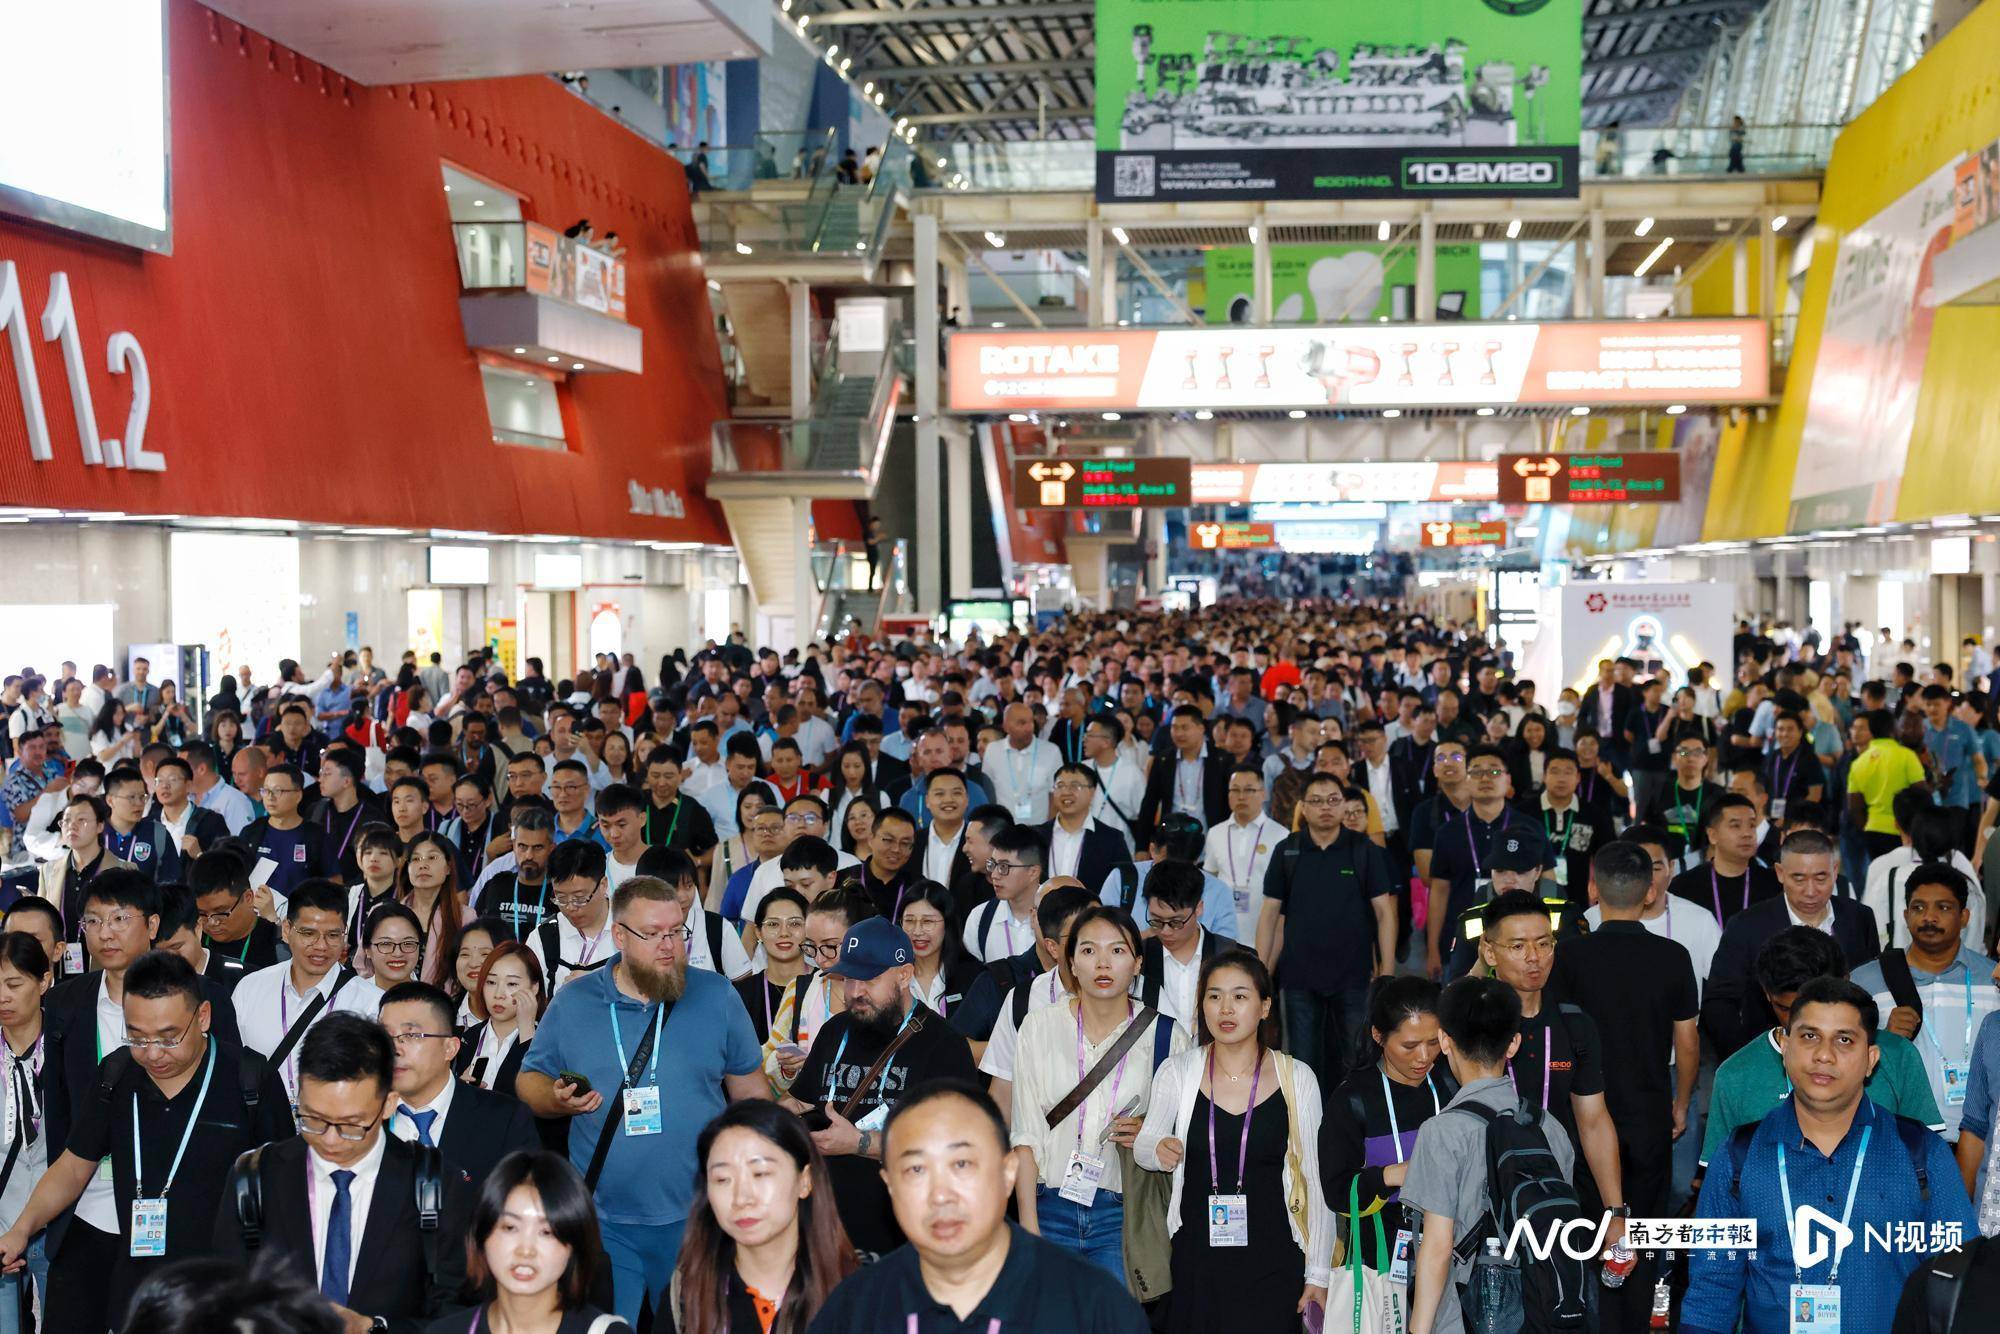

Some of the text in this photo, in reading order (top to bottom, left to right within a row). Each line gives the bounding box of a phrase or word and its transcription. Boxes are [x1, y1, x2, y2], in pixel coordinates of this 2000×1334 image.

[1408, 162, 1553, 183] 10.2M20
[0, 259, 167, 472] 11.2
[980, 344, 1120, 374] ROTAKE
[499, 902, 546, 915] STANDARD
[847, 937, 859, 954] P
